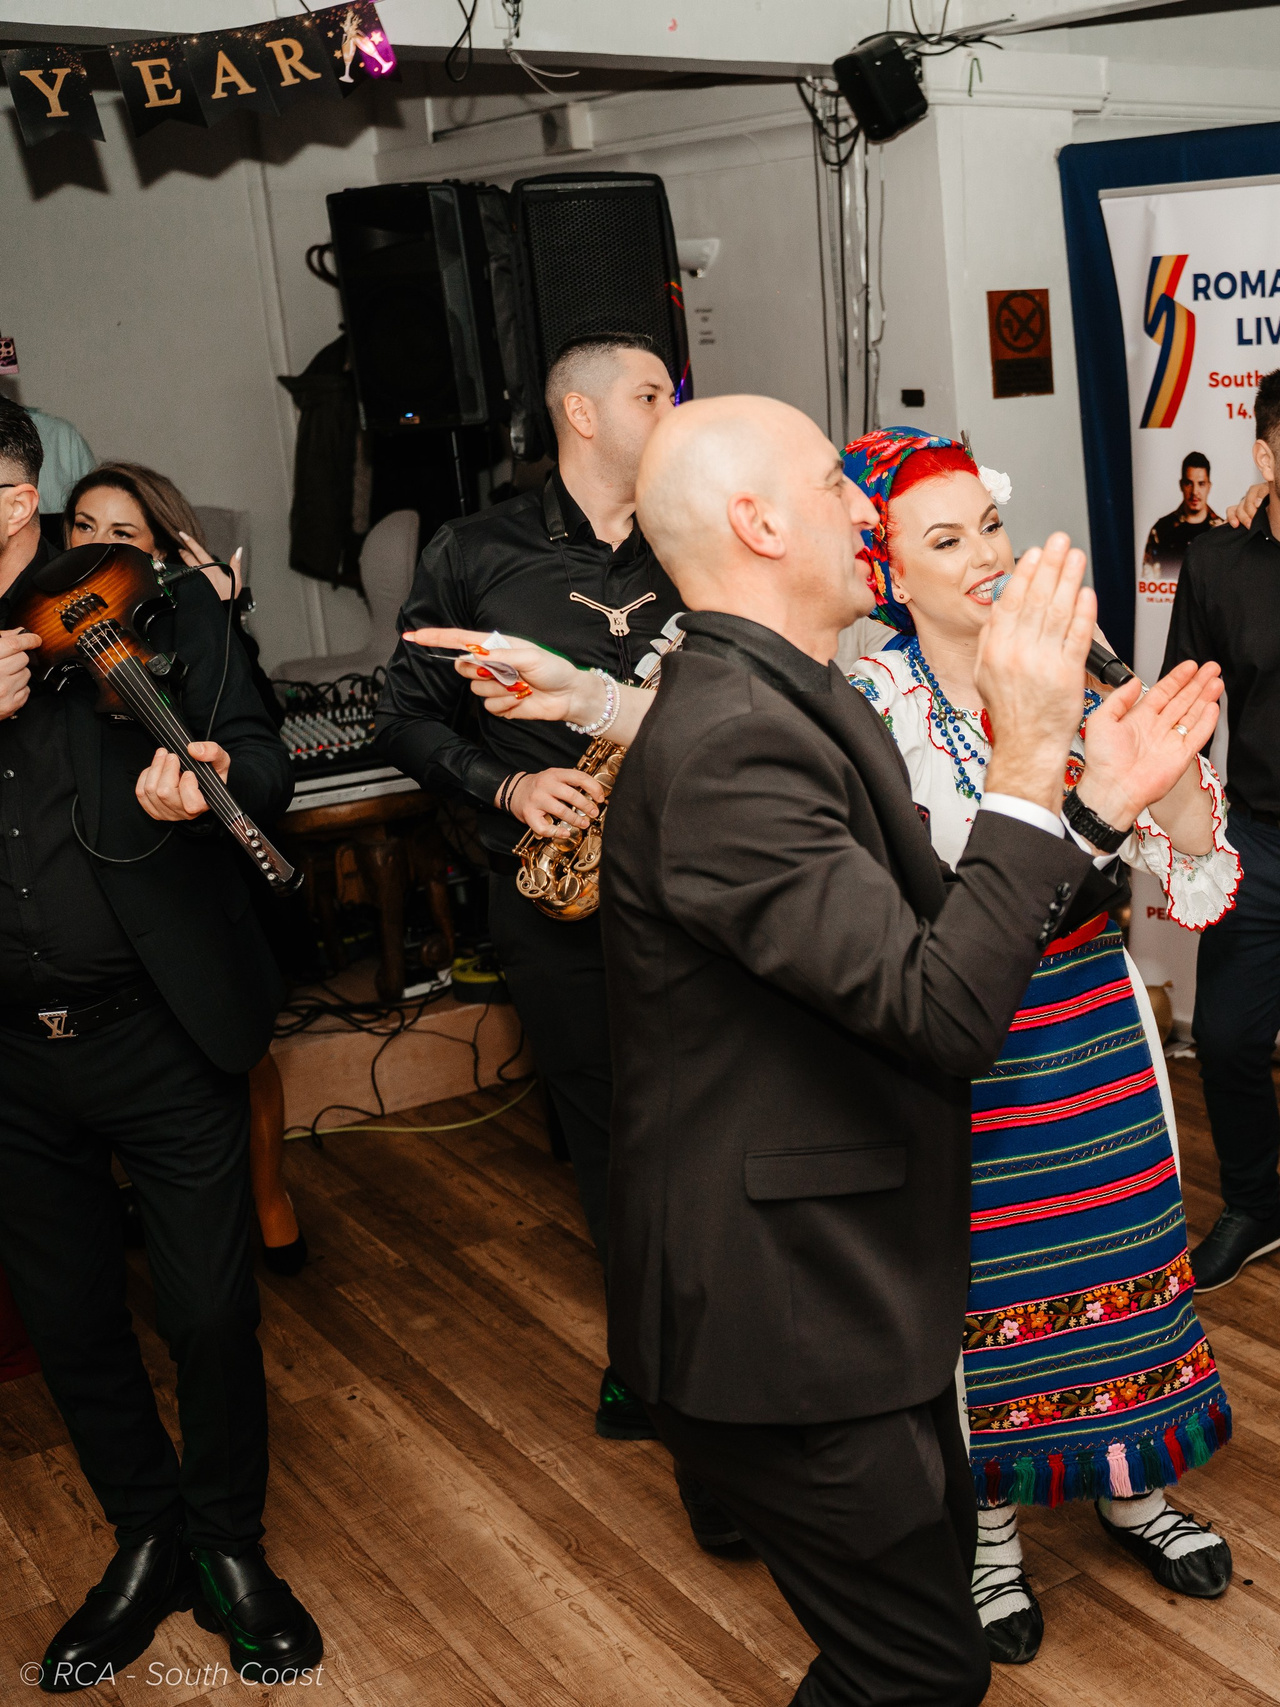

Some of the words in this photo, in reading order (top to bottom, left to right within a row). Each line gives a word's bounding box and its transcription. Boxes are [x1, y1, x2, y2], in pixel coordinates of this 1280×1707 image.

[19, 37, 322, 118] YEAR
[1226, 402, 1255, 419] 14.
[1147, 906, 1170, 920] PE
